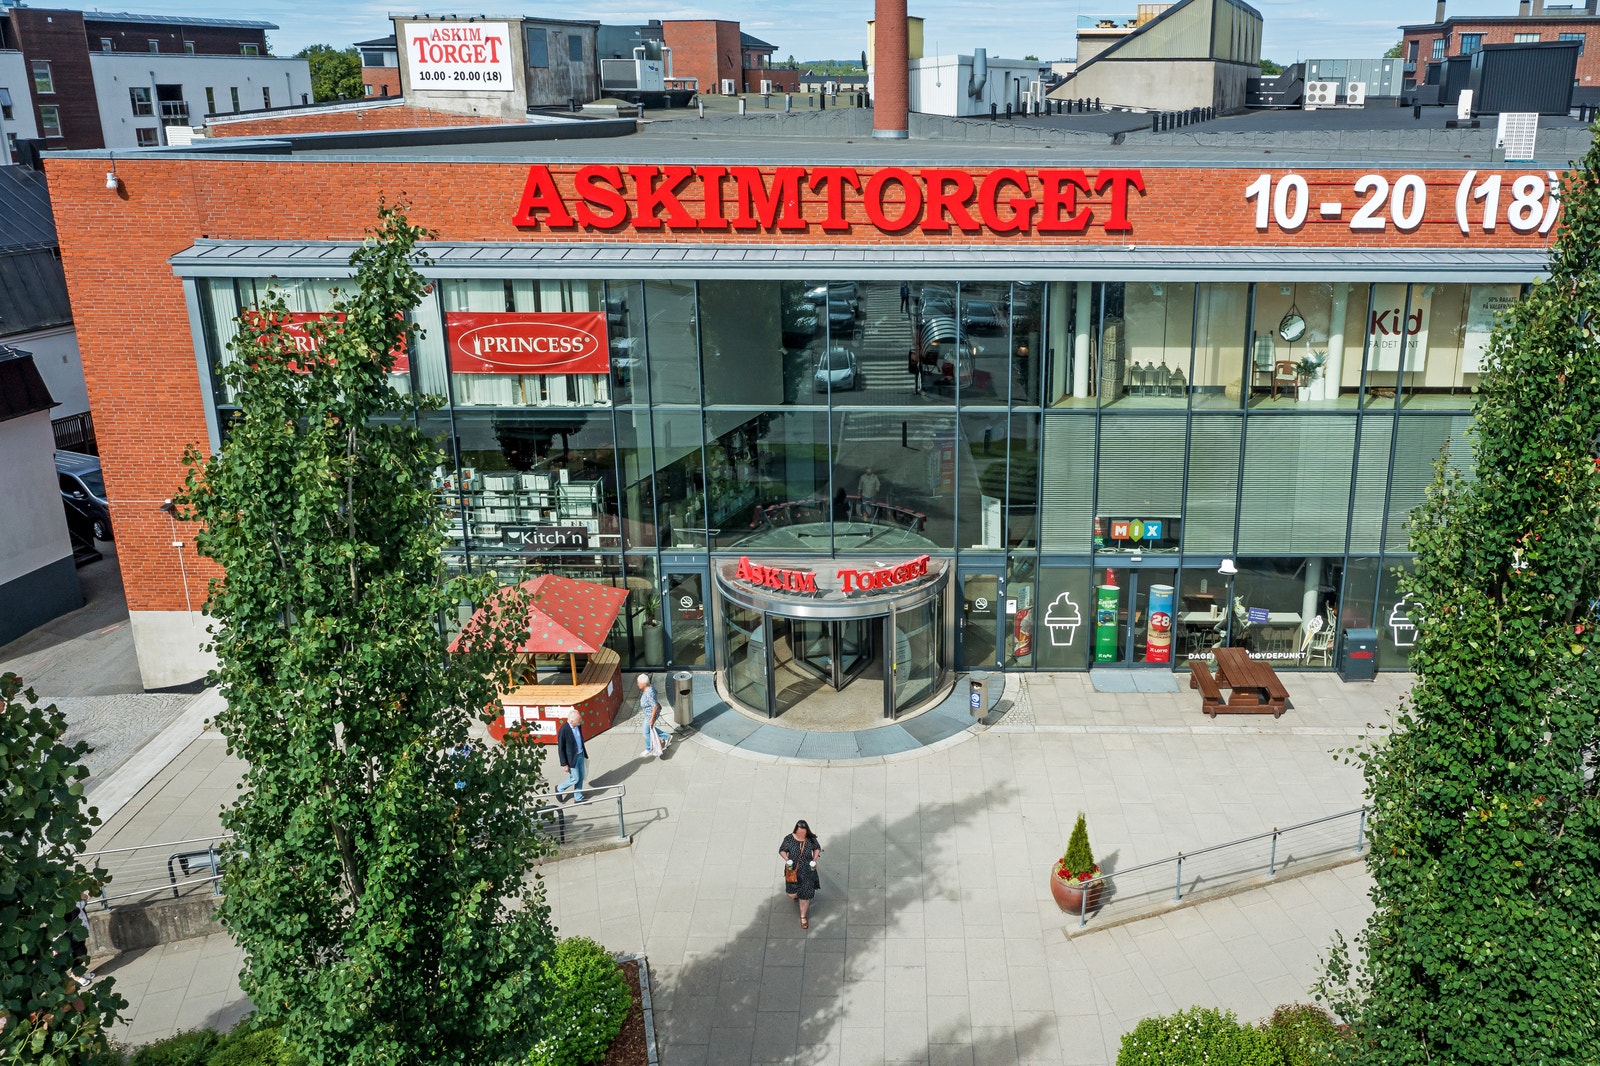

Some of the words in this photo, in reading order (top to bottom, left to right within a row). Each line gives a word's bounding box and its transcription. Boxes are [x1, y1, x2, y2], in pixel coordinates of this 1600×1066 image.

[432, 28, 481, 41] ASKIM
[413, 37, 502, 63] TORGET
[419, 71, 446, 81] 10.00
[453, 71, 480, 81] 20.00
[483, 71, 502, 83] (18)
[511, 164, 1147, 233] ASKIMTORGET
[1455, 170, 1561, 233] (18)
[1370, 308, 1423, 335] Kid
[1382, 340, 1398, 348] DET
[1114, 525, 1158, 537] MIX
[735, 556, 817, 592] ASKIM
[836, 554, 930, 593] TORGET
[1151, 614, 1170, 627] 28
[1249, 652, 1306, 660] HØYDEPUNKT
